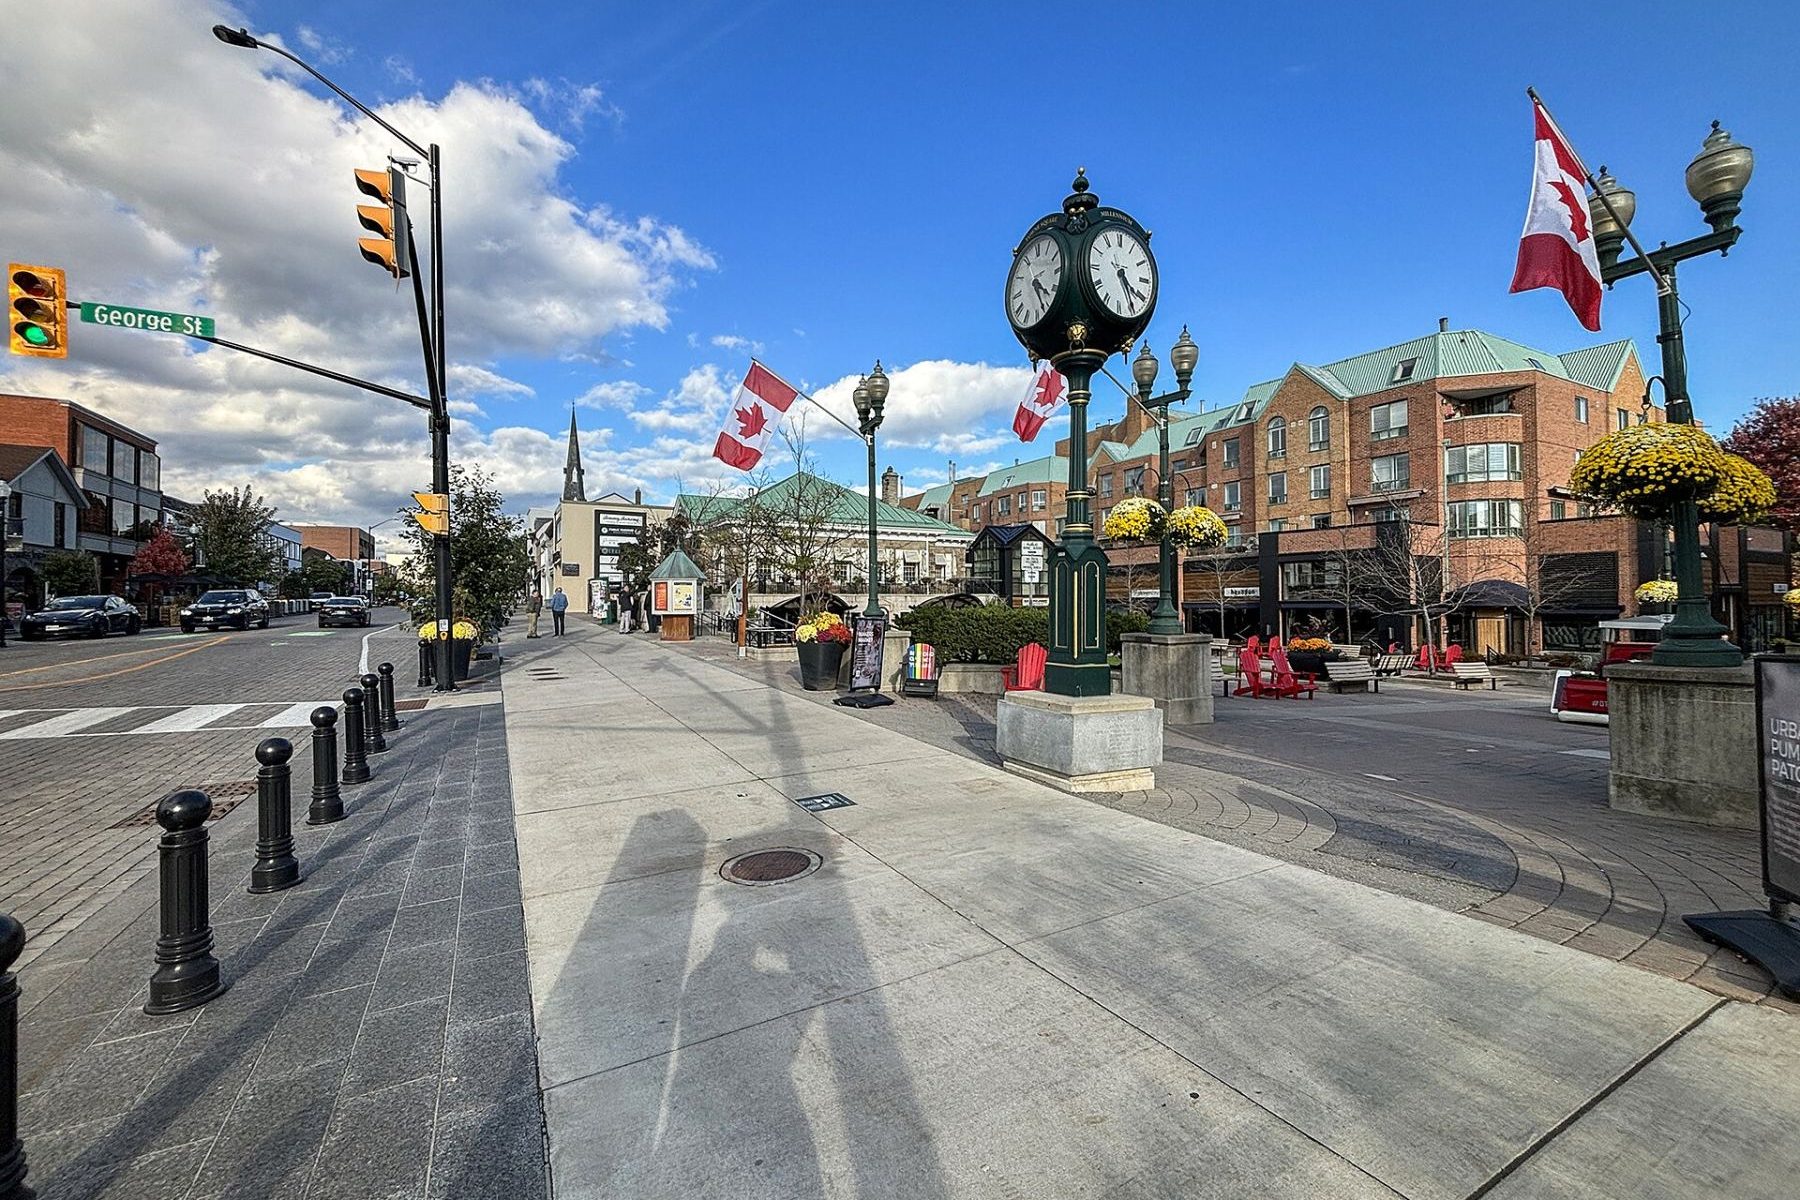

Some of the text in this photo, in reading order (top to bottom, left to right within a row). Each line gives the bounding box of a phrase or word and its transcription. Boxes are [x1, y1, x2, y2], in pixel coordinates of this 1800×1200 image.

[1100, 211, 1133, 225] MILLENNIUM
[94, 305, 203, 336] George St
[1770, 718, 1800, 739] URB
